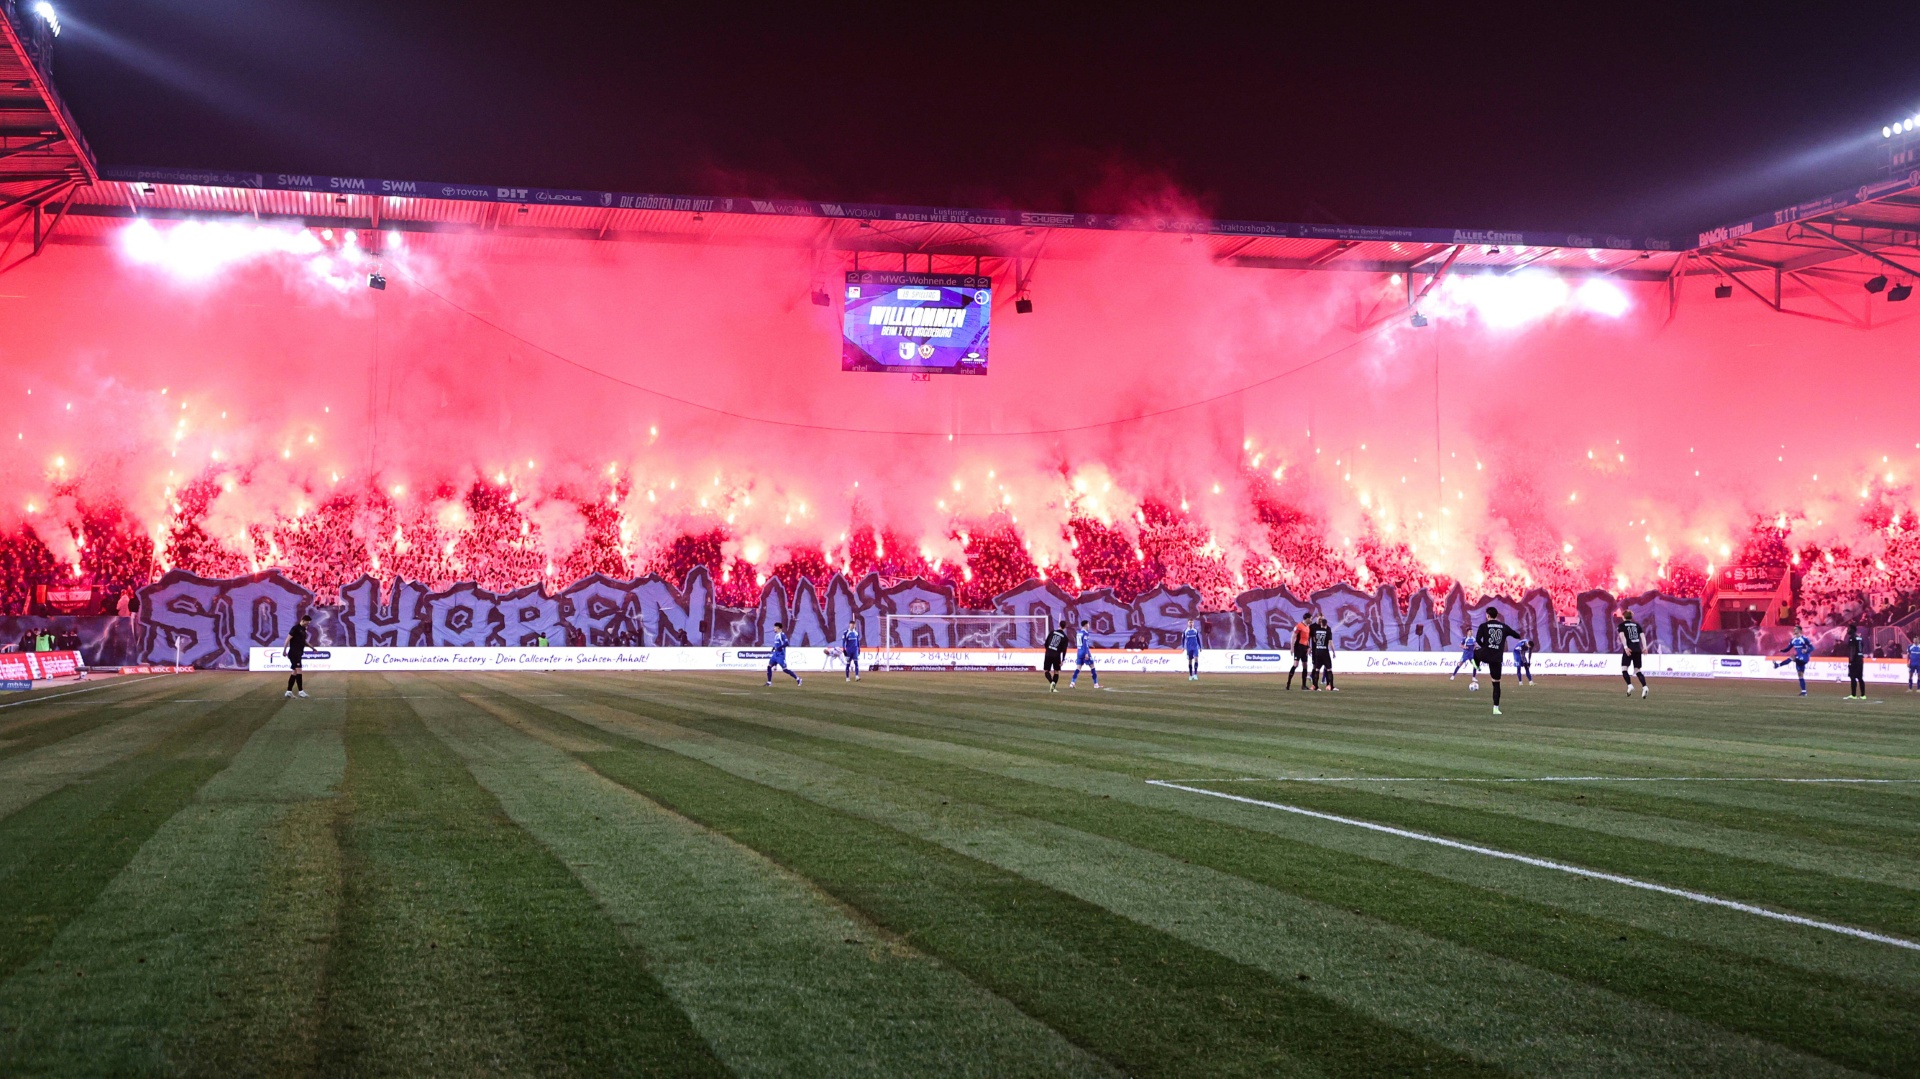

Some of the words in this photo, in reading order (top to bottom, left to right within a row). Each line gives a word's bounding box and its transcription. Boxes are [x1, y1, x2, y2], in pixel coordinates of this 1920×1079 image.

[278, 174, 313, 187] SWM
[330, 177, 365, 190] SWM
[382, 180, 417, 192] SWM
[457, 188, 489, 197] TOYOTA
[620, 195, 634, 209] DIE
[674, 198, 690, 211] DER
[693, 199, 714, 212] WELT
[776, 205, 812, 215] WOBAU
[845, 208, 881, 218] WOBAU
[895, 212, 928, 222] BADEN
[930, 214, 948, 223] WIE
[950, 215, 966, 224] DIE
[1454, 229, 1524, 242] ALLEE-CENTER
[880, 274, 957, 286] MWG-Wohnen.de
[868, 305, 967, 328] WILLKOMMEN
[913, 327, 953, 338] MAGDEBURG
[852, 364, 868, 372] intel
[961, 367, 976, 375] intel
[364, 653, 380, 665] Die
[382, 653, 450, 665] Communication
[453, 653, 486, 667] Factory
[496, 653, 516, 665] Dein
[518, 653, 562, 665] Callcenter
[564, 655, 573, 665] in
[576, 653, 649, 665] Sachsen-Anhalt!
[1105, 656, 1115, 664] als
[1118, 656, 1128, 664] ein
[1131, 655, 1171, 665] Callcenter
[1366, 656, 1380, 667] Die
[1382, 657, 1437, 668] Communication
[1544, 658, 1608, 670] Sachsen-Anhalt!
